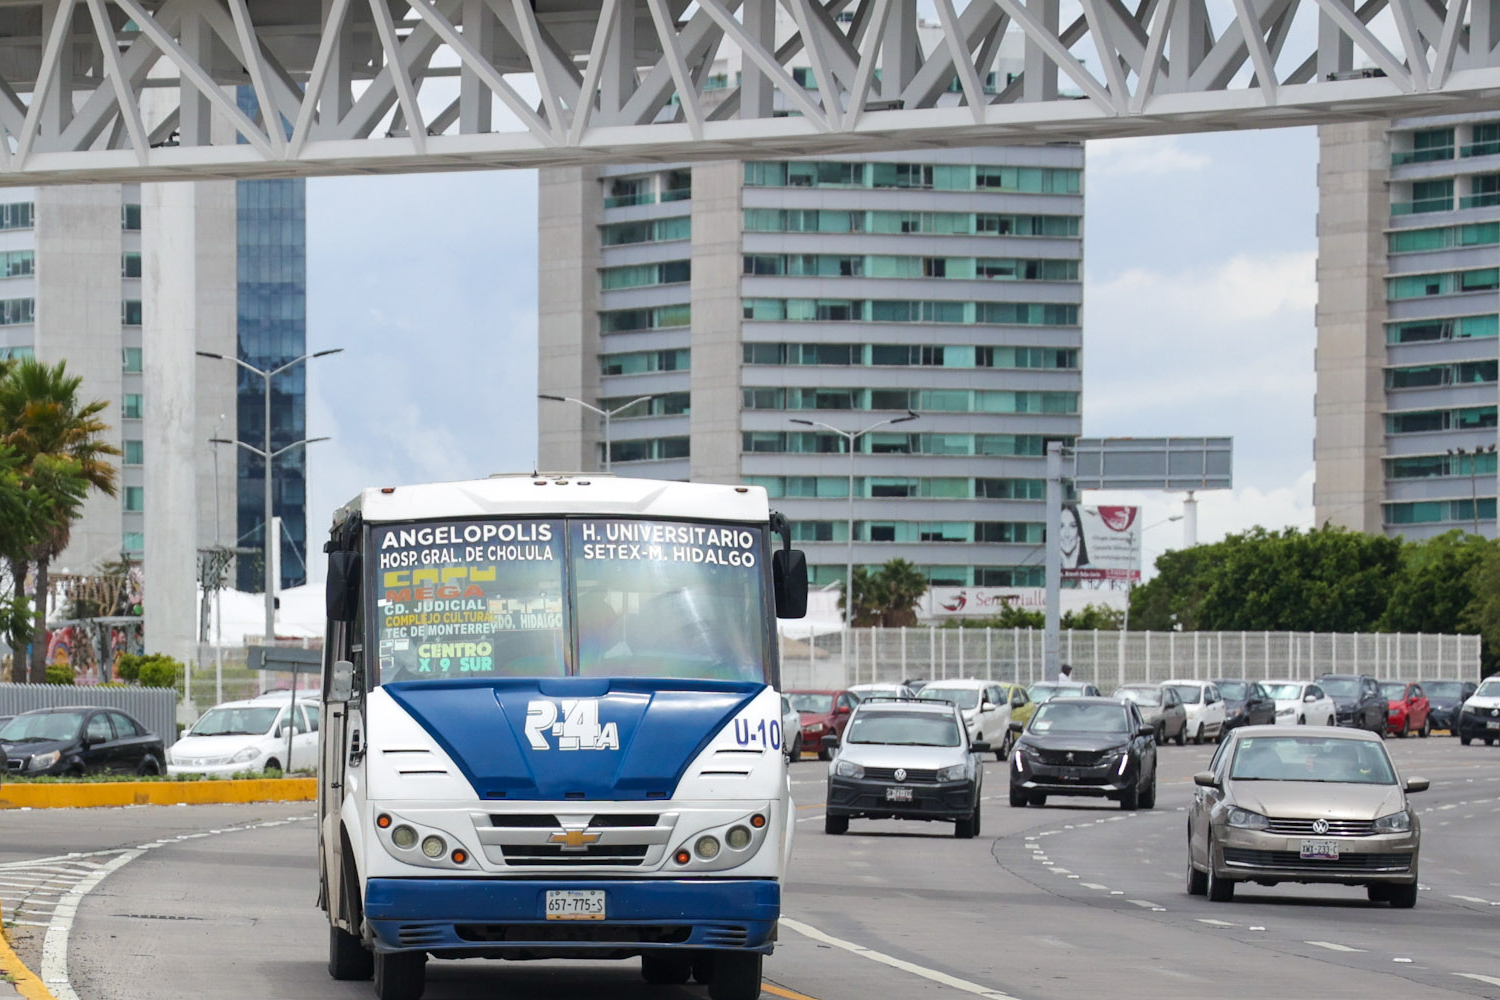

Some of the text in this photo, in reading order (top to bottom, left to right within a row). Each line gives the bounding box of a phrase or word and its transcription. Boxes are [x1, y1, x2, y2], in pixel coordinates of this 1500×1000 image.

[381, 523, 553, 550] ANGELOPOLIS
[582, 523, 754, 549] H. UNIVERSITARIO
[380, 545, 553, 569] HOSP. GRAL. DE CHOLULA
[583, 543, 756, 568] SETEX-M. HIDALGO
[385, 584, 485, 602] MEGA
[384, 599, 486, 616] CD. JUDICIAL
[385, 612, 440, 627] COMPLEJO
[386, 622, 497, 639] TEC DE MONTERREY
[418, 641, 492, 658] CENTRO
[419, 656, 492, 672] X 9 SUR
[734, 718, 781, 751] U-10
[548, 898, 603, 911] 657-775-S
